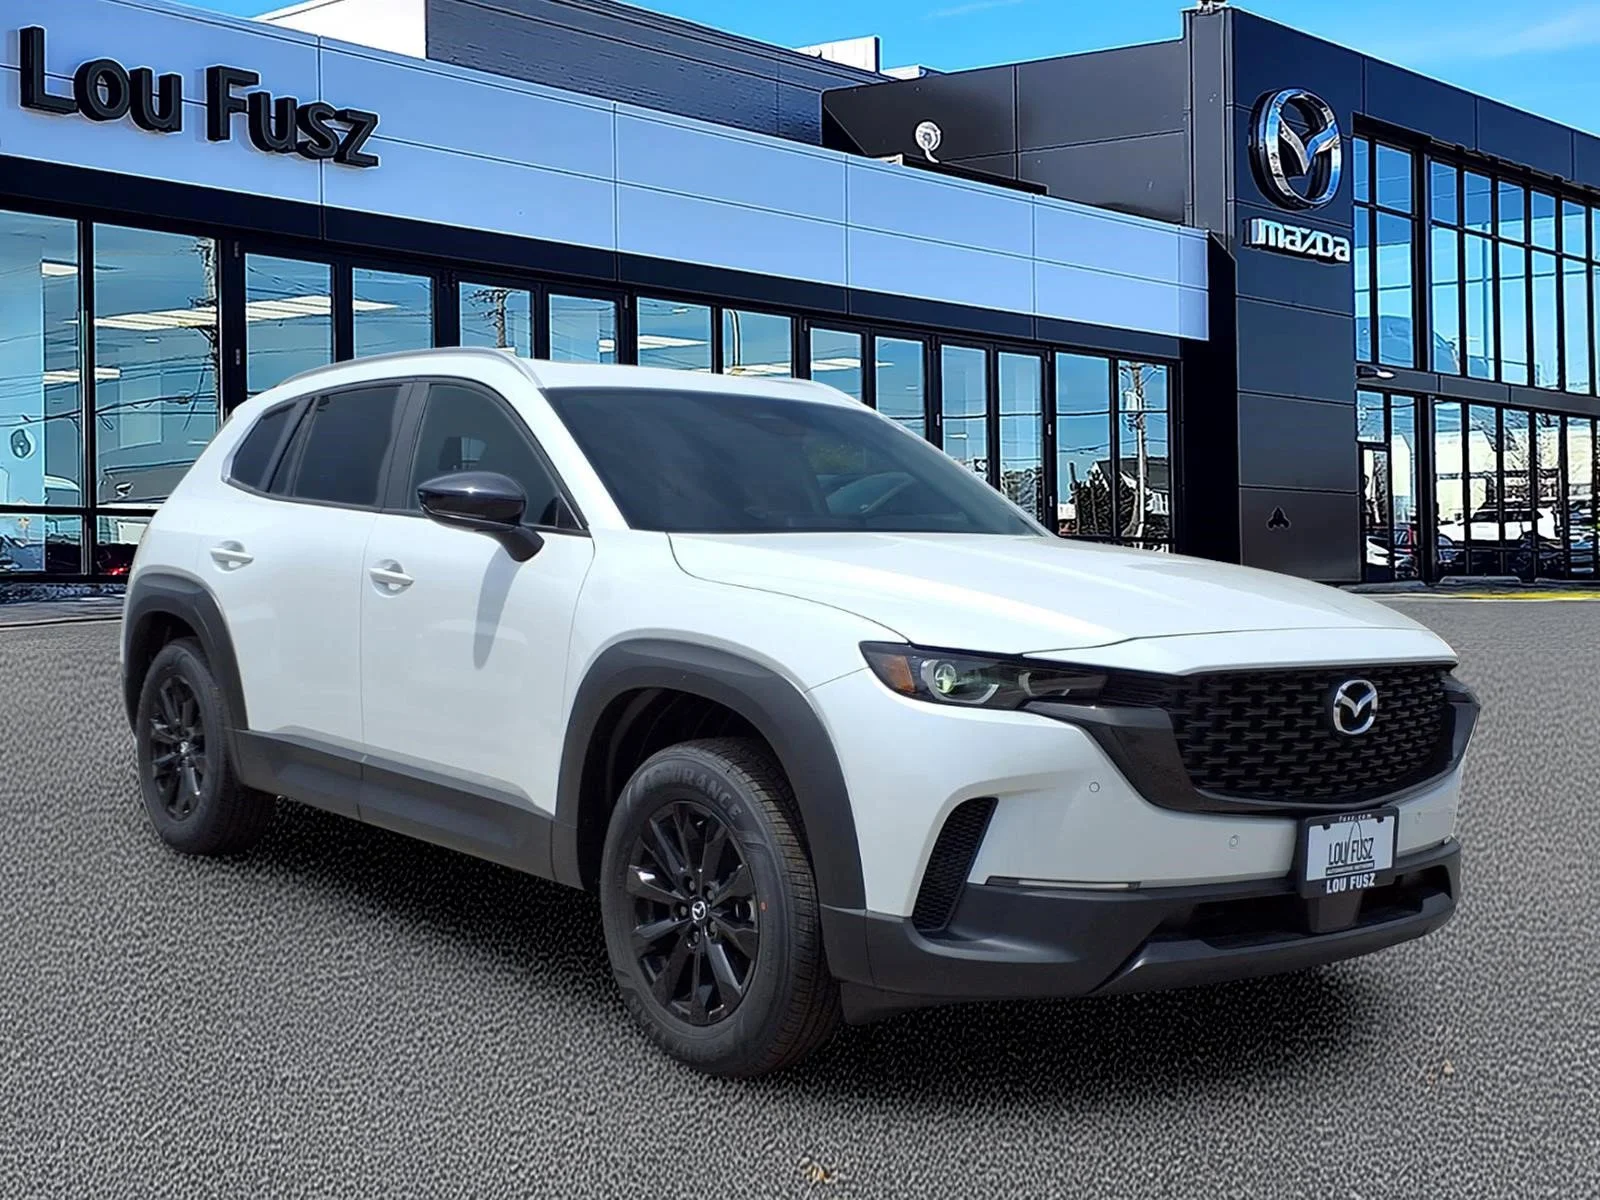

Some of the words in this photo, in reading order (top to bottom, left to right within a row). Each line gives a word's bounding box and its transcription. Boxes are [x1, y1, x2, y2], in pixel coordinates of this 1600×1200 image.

[19, 26, 182, 133] Lou
[206, 65, 379, 168] Fusz
[1329, 841, 1348, 865] LOU
[1351, 837, 1374, 862] FUSZ
[1326, 876, 1347, 894] LOU
[1349, 873, 1376, 890] FUSZ
